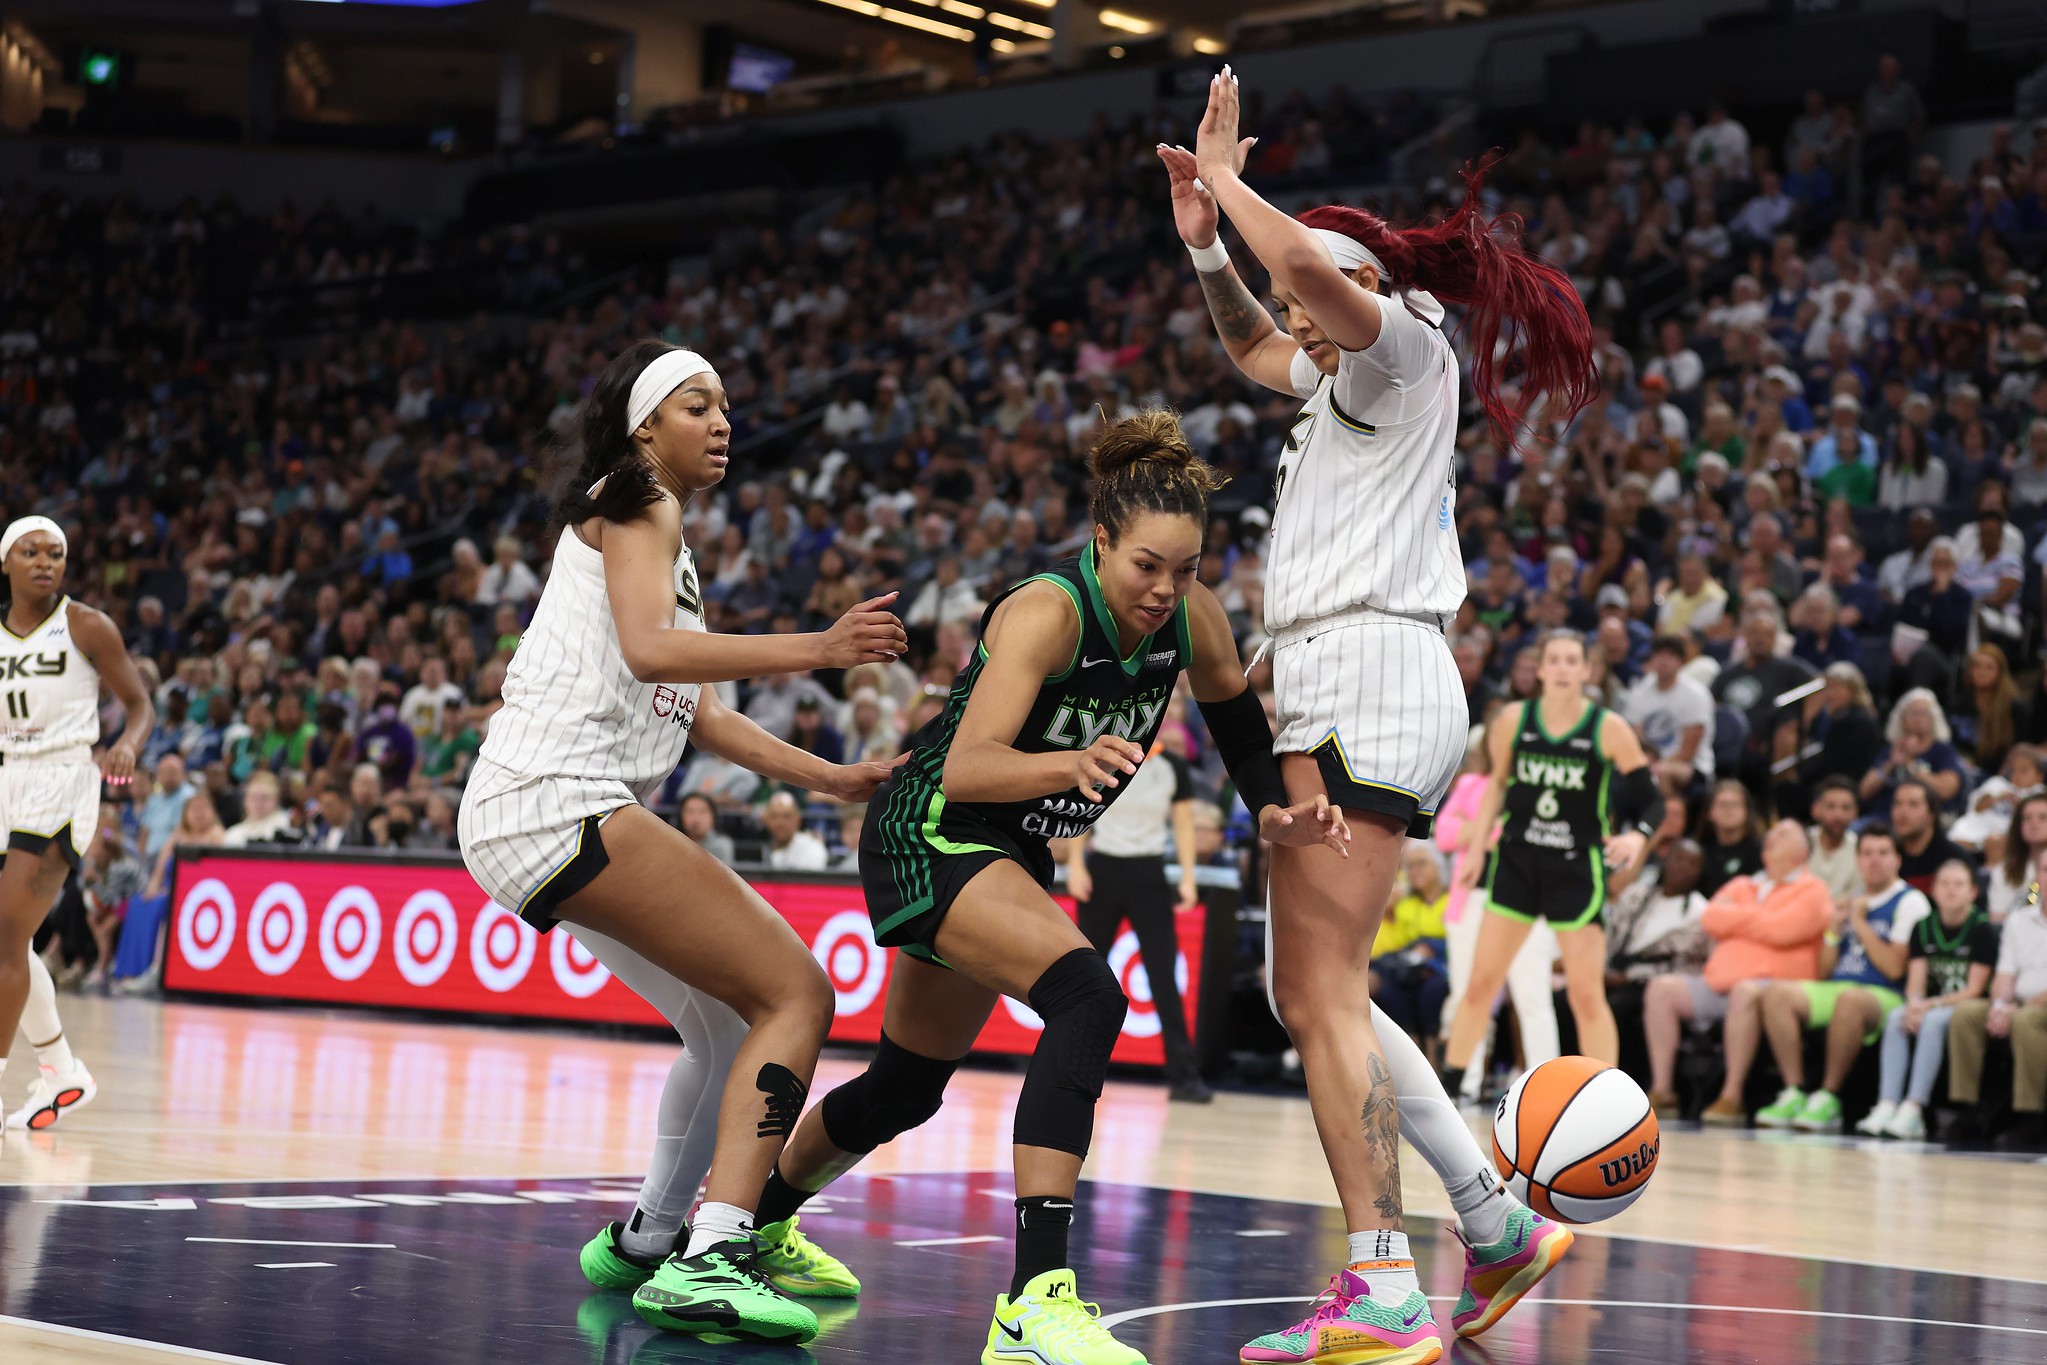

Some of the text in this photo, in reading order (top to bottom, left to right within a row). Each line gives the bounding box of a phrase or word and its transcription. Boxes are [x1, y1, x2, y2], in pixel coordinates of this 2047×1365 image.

[1145, 650, 1177, 662] FEDERATED
[7, 690, 29, 719] 11
[1042, 696, 1167, 750] LYNX
[1517, 757, 1587, 791] LYNX
[1040, 799, 1106, 818] MAYO
[1536, 788, 1559, 819] 6
